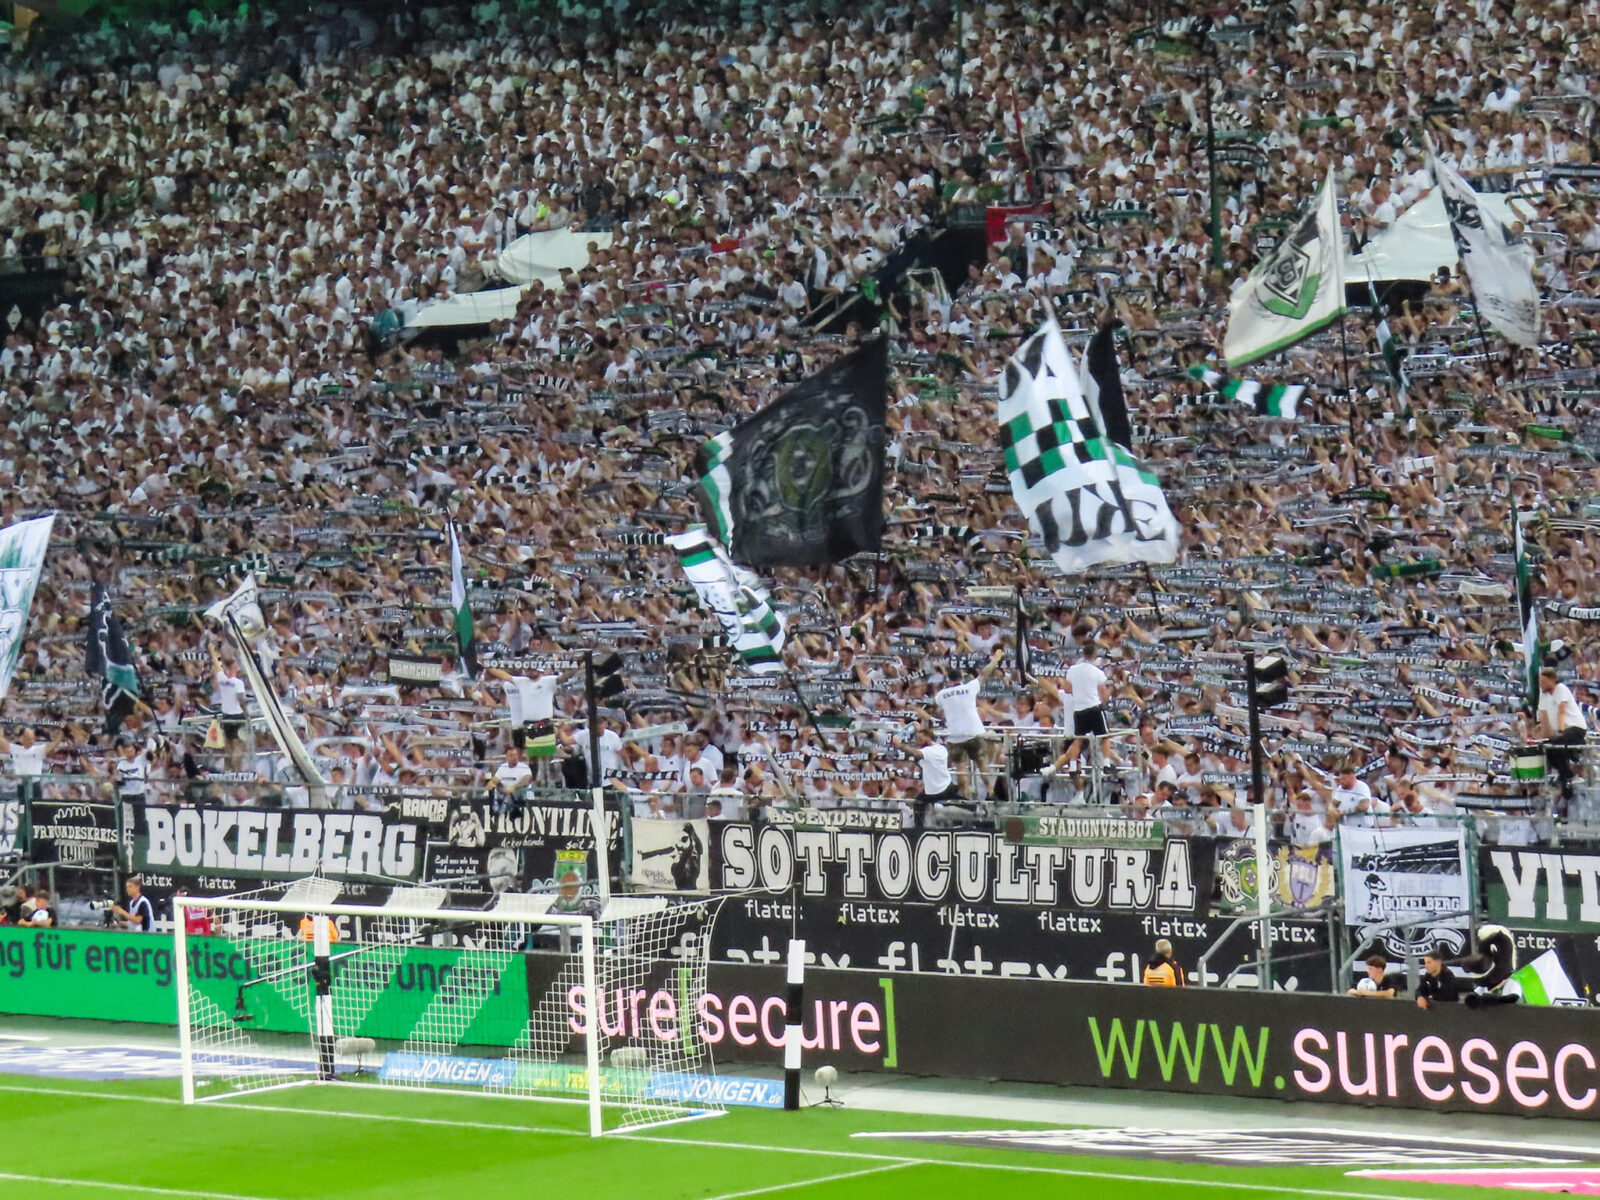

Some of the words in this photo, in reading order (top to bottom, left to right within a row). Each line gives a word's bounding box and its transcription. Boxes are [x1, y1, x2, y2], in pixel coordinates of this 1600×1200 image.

[482, 804, 619, 840] FRONTLINE
[769, 807, 901, 830] ASCENDENTE
[1039, 817, 1154, 839] STADIONVERBOT
[33, 825, 118, 842] FREUNDESKREIS
[145, 803, 418, 877] BÖKELBERG
[721, 824, 1197, 912] SOTTOCULTURA
[198, 875, 236, 890] flatex
[840, 903, 900, 924] flatex
[937, 906, 999, 928] flatex
[1038, 911, 1101, 933] flatex
[1141, 916, 1207, 938] flatex
[33, 932, 76, 970] für
